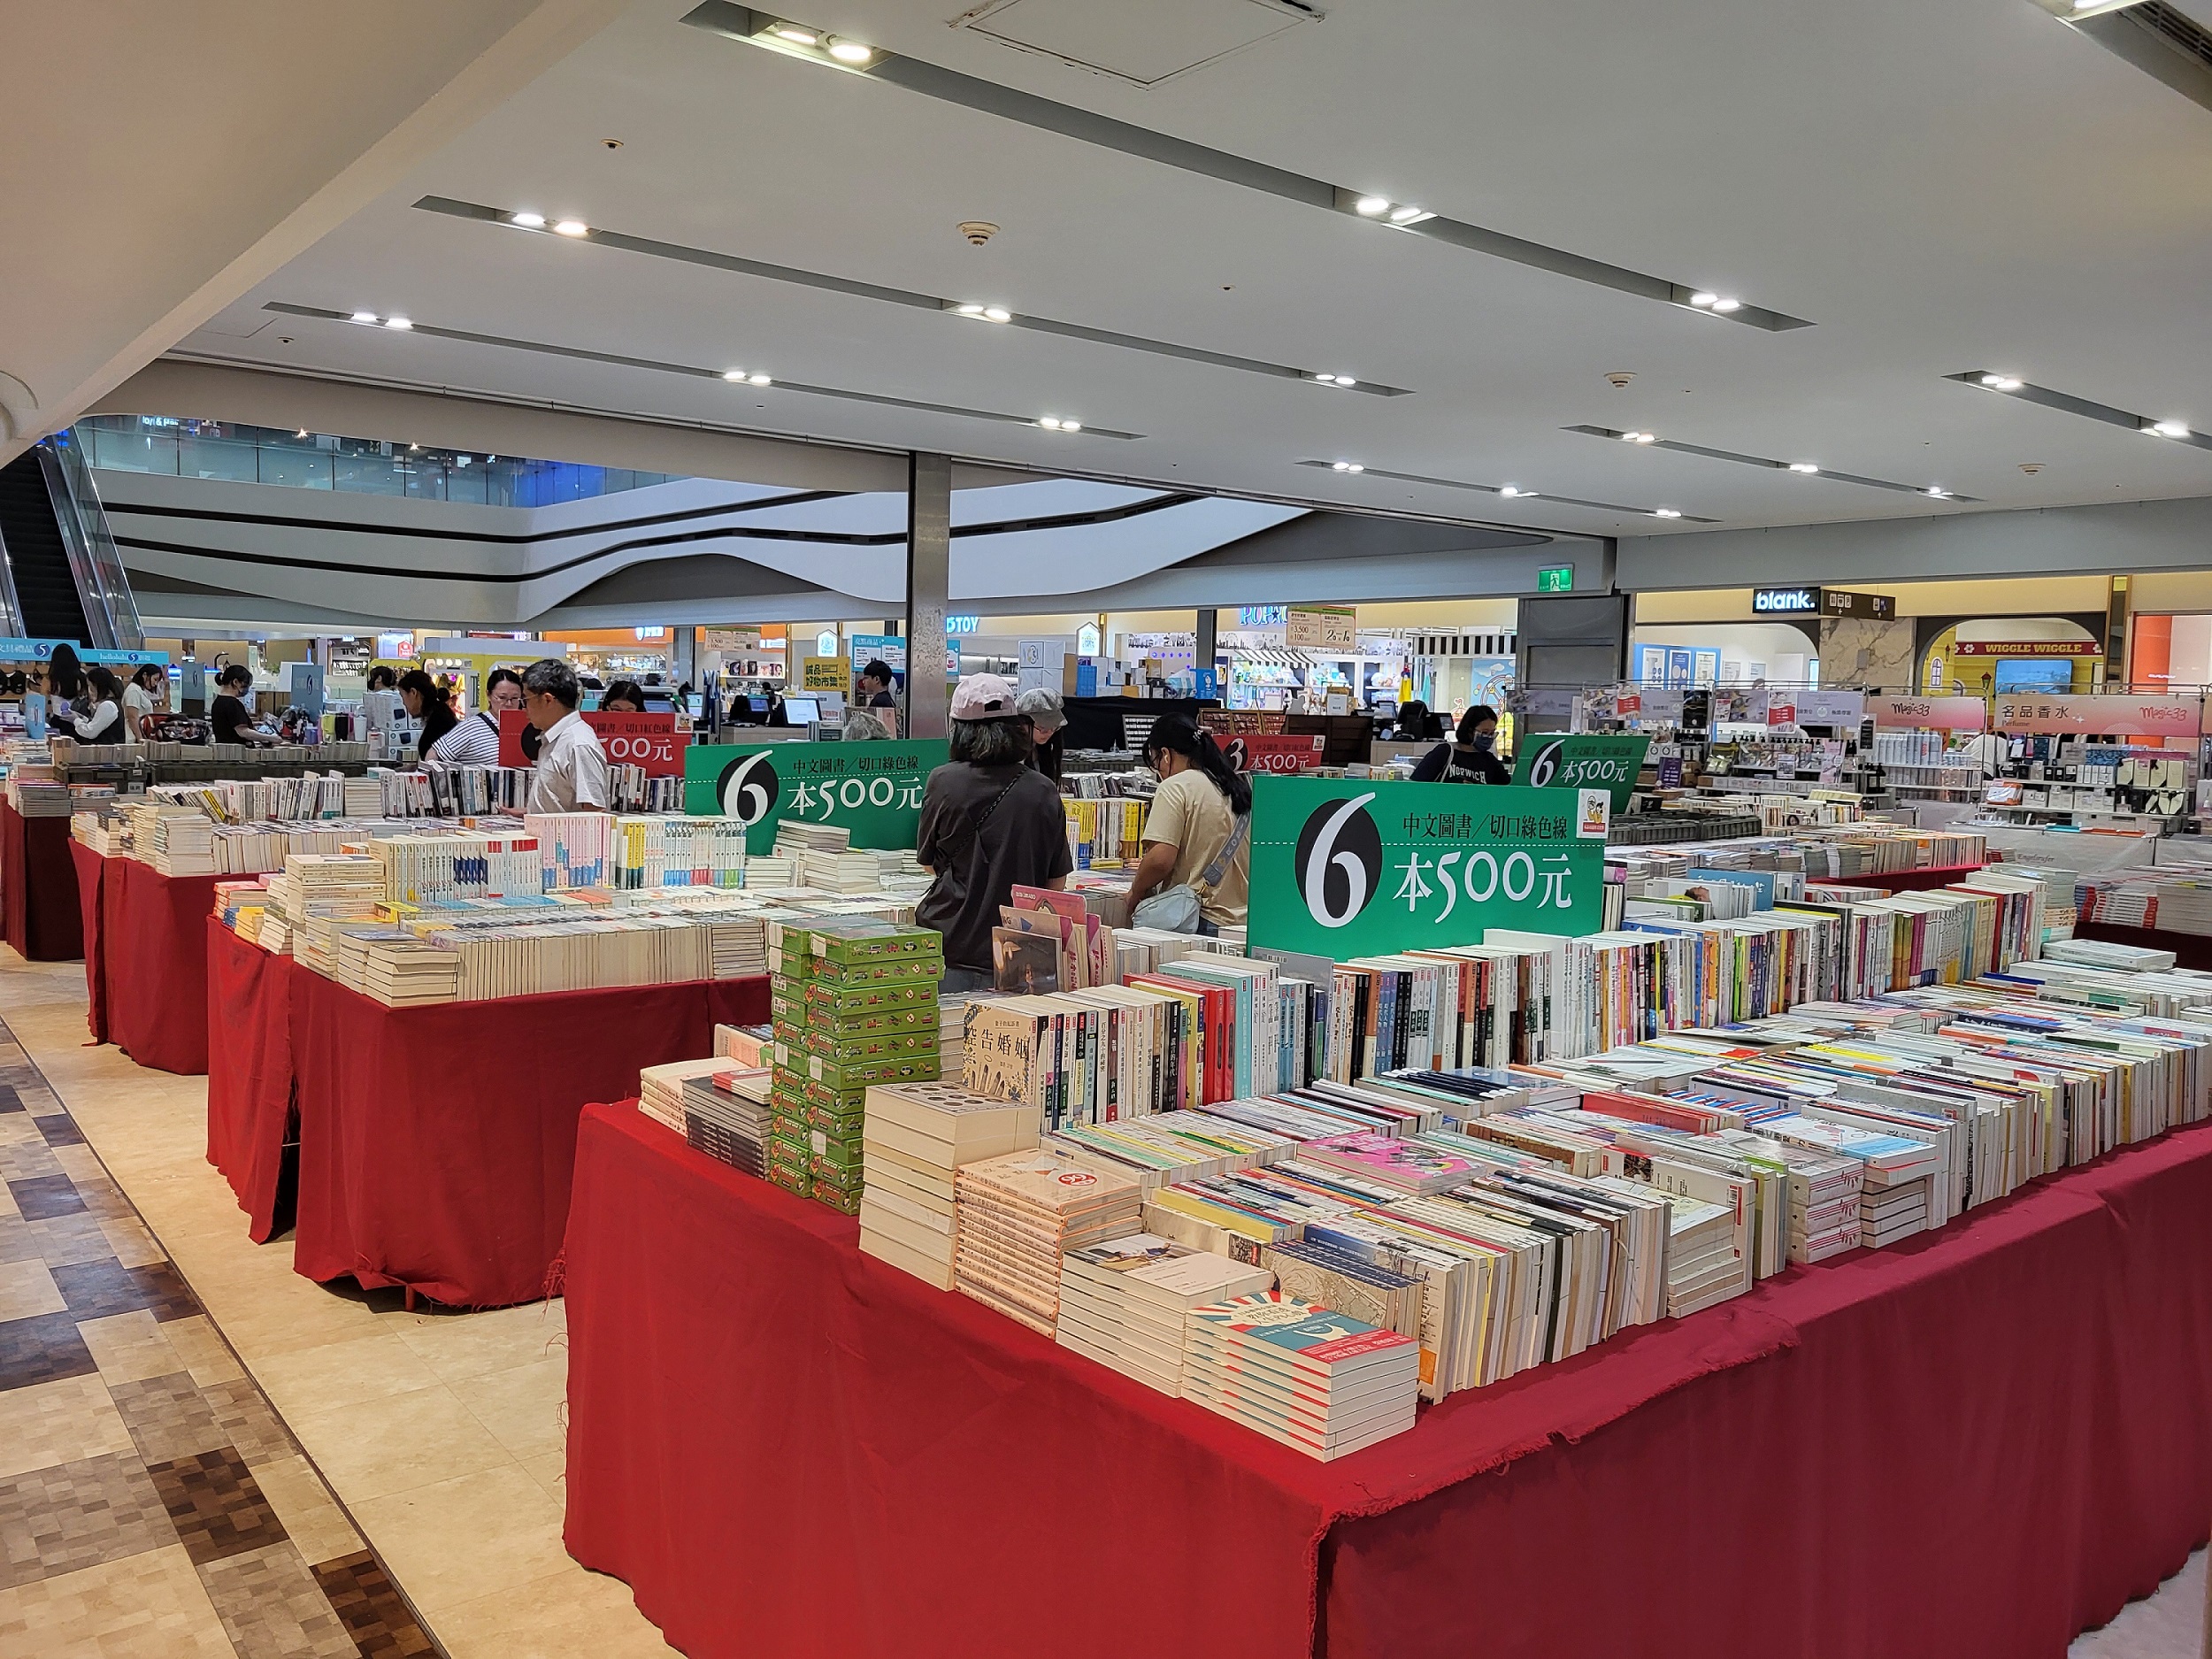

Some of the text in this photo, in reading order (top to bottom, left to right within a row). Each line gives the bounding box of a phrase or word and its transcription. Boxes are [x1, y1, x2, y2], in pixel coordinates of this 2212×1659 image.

[1755, 591, 1816, 610] blank.
[1985, 644, 2082, 653] WIGGLE WIGGLE
[1892, 703, 1931, 717] Magic33
[2001, 705, 2069, 719] 名品香水
[2139, 706, 2187, 721] Magic33
[1449, 764, 1487, 785] NORWICH
[1530, 739, 1565, 788] 6
[1560, 759, 1630, 787] 本500元
[723, 749, 773, 826] 6
[787, 776, 924, 822] 本500元
[1305, 792, 1376, 928] 6
[1393, 850, 1573, 924] 本500元
